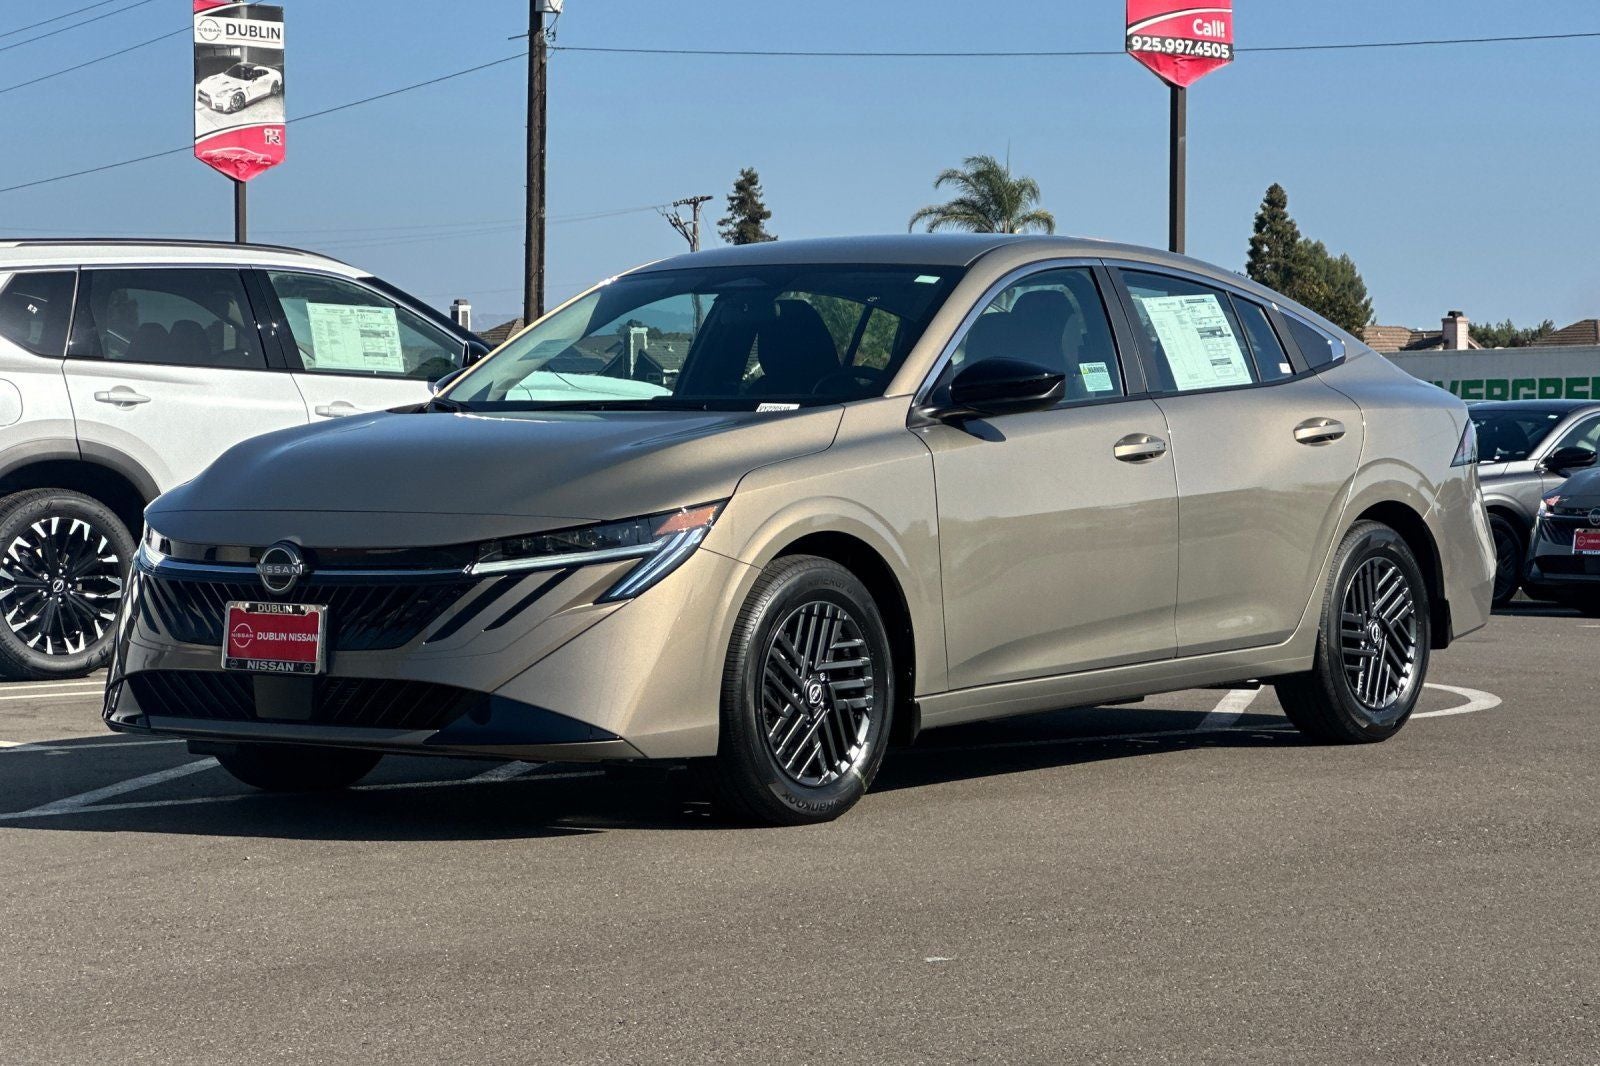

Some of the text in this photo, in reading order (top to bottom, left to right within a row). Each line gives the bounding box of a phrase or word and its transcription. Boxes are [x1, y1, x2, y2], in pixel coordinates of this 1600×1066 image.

[226, 23, 281, 40] DUBLIN
[1193, 19, 1225, 38] Call!
[1131, 36, 1230, 59] 925.997.4505
[256, 564, 302, 575] NISSAN
[257, 603, 293, 614] DUBLIN
[256, 632, 287, 641] DUBLIN
[288, 633, 318, 643] NISSAN
[246, 660, 295, 671] NISSAN
